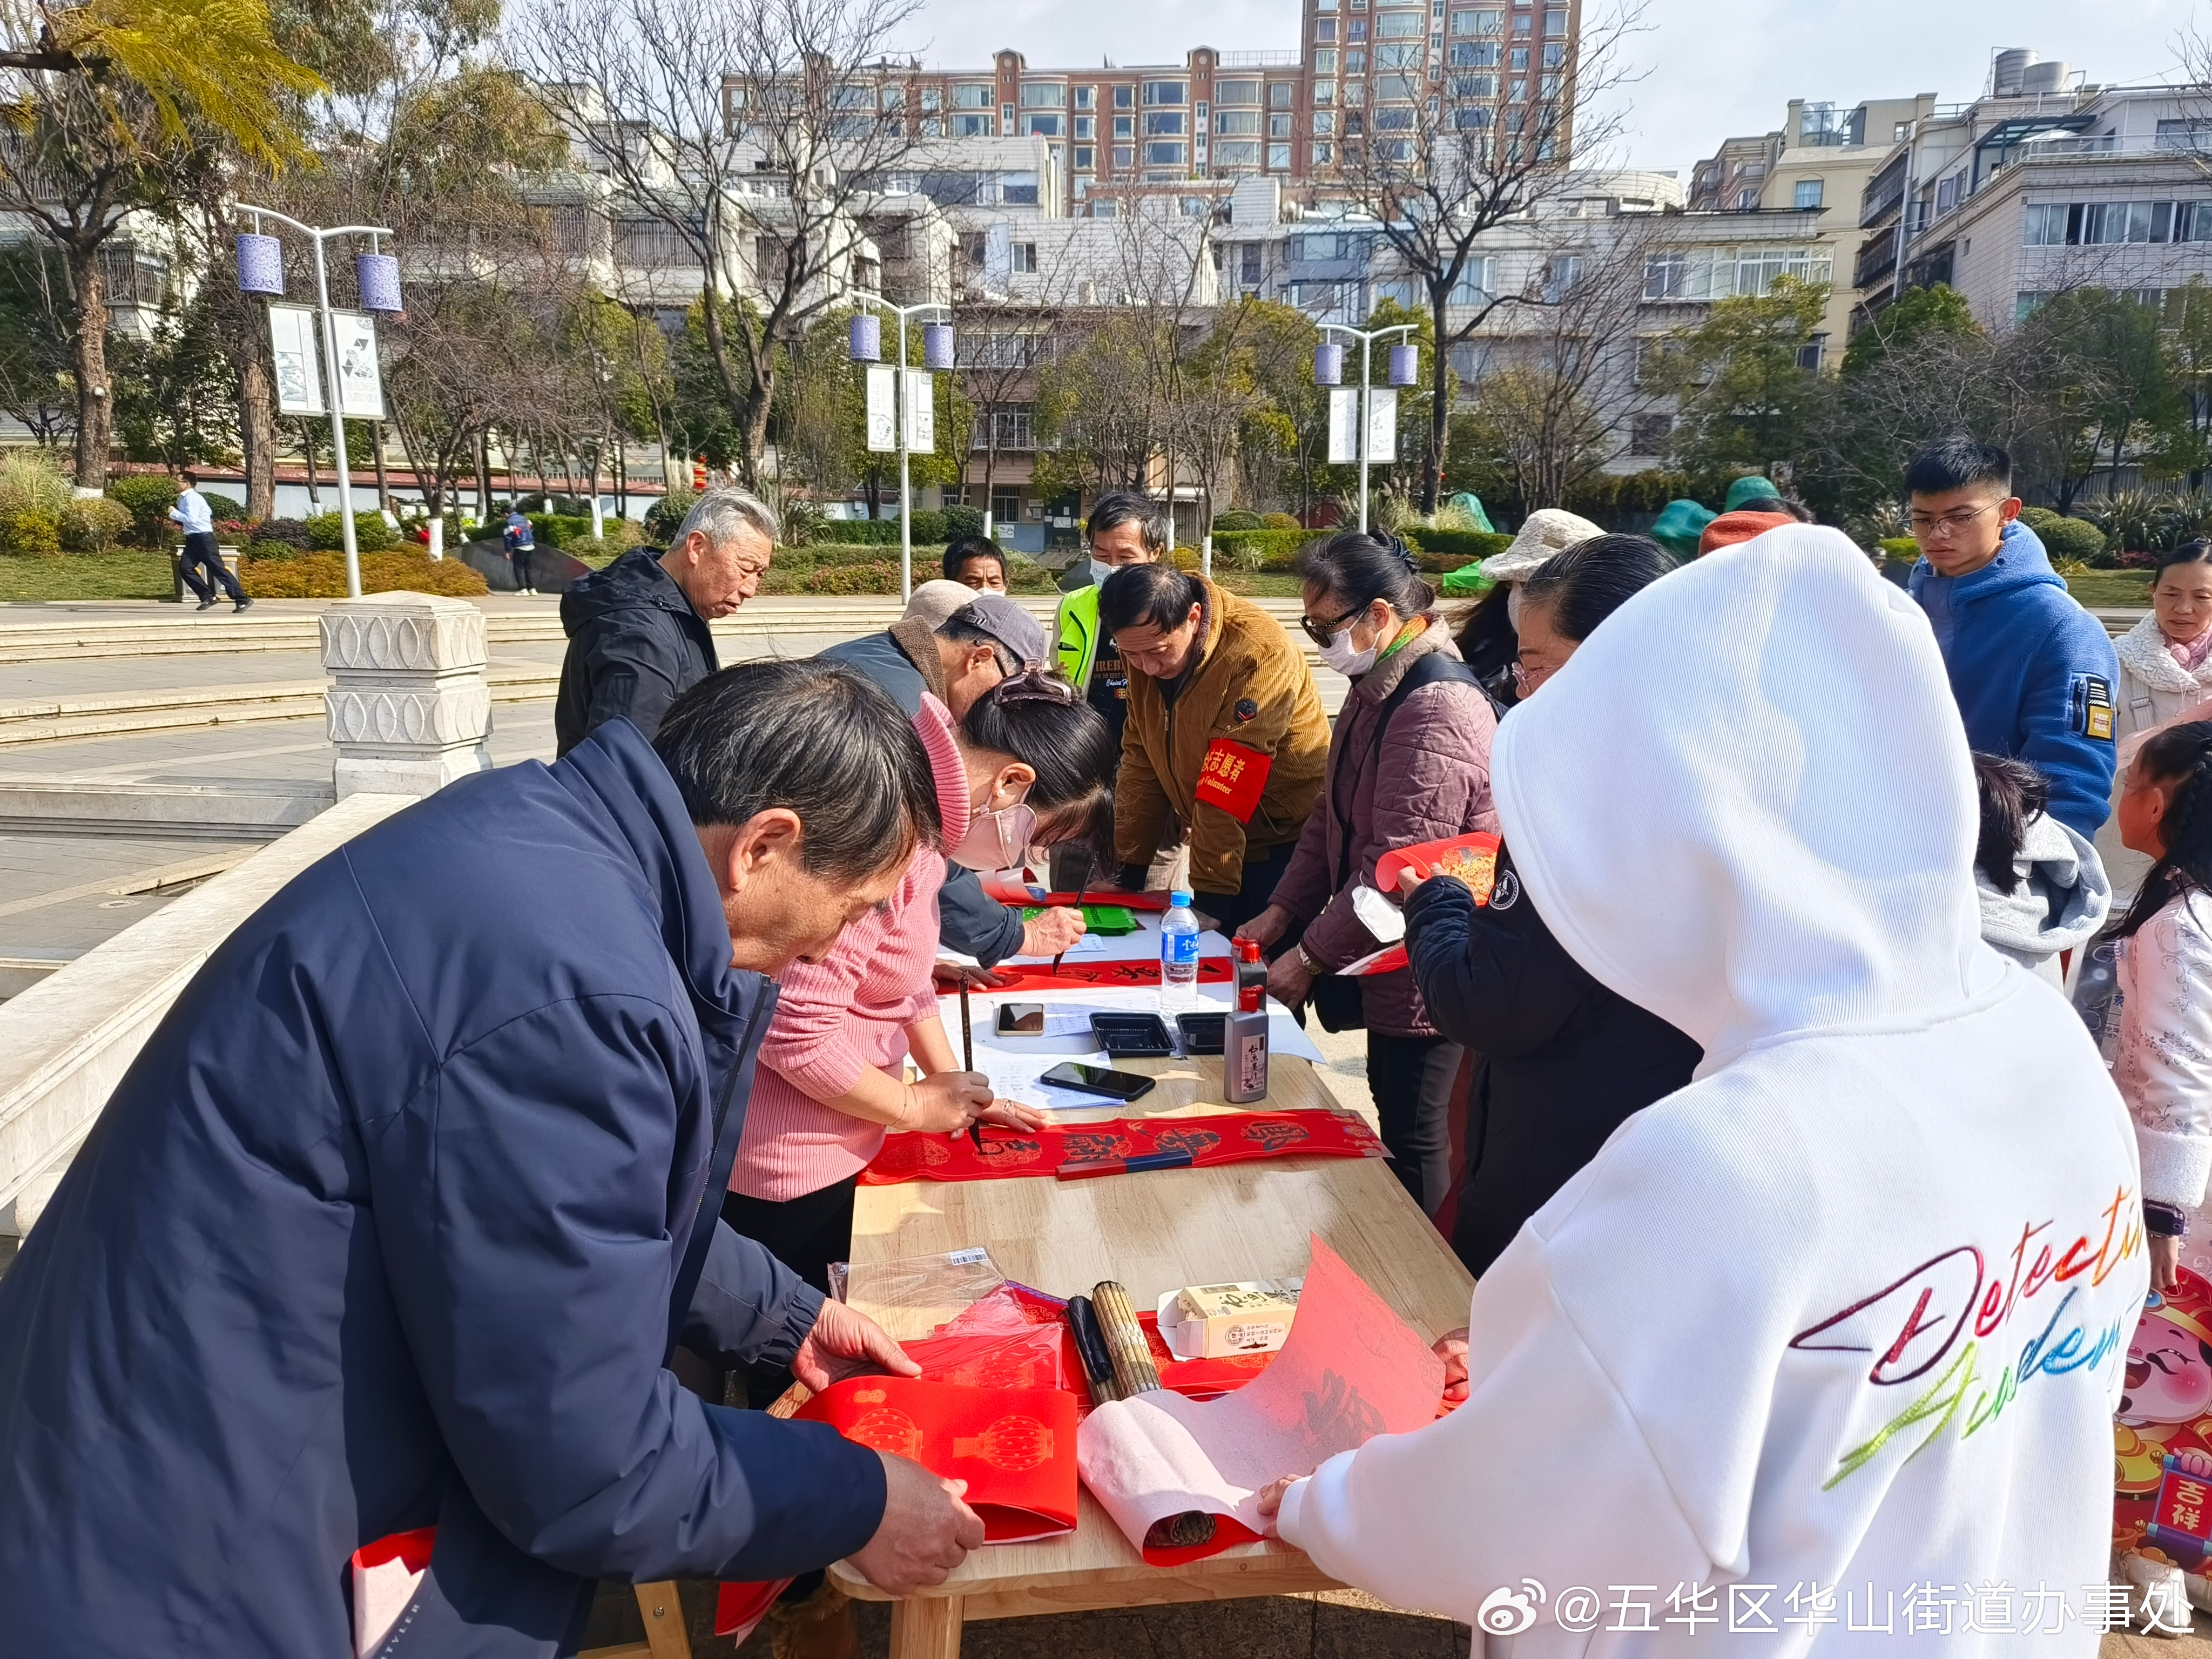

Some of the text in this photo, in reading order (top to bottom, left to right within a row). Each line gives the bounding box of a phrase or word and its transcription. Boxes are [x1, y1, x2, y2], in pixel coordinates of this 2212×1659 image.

[1095, 660, 1123, 671] IREB
[1204, 775, 1232, 795] Volunteer
[1788, 1184, 2144, 1386] Detecti
[1821, 1286, 2125, 1492] Academ
[2172, 1479, 2207, 1530] 吉祥
[380, 1604, 420, 1659] TYLER
